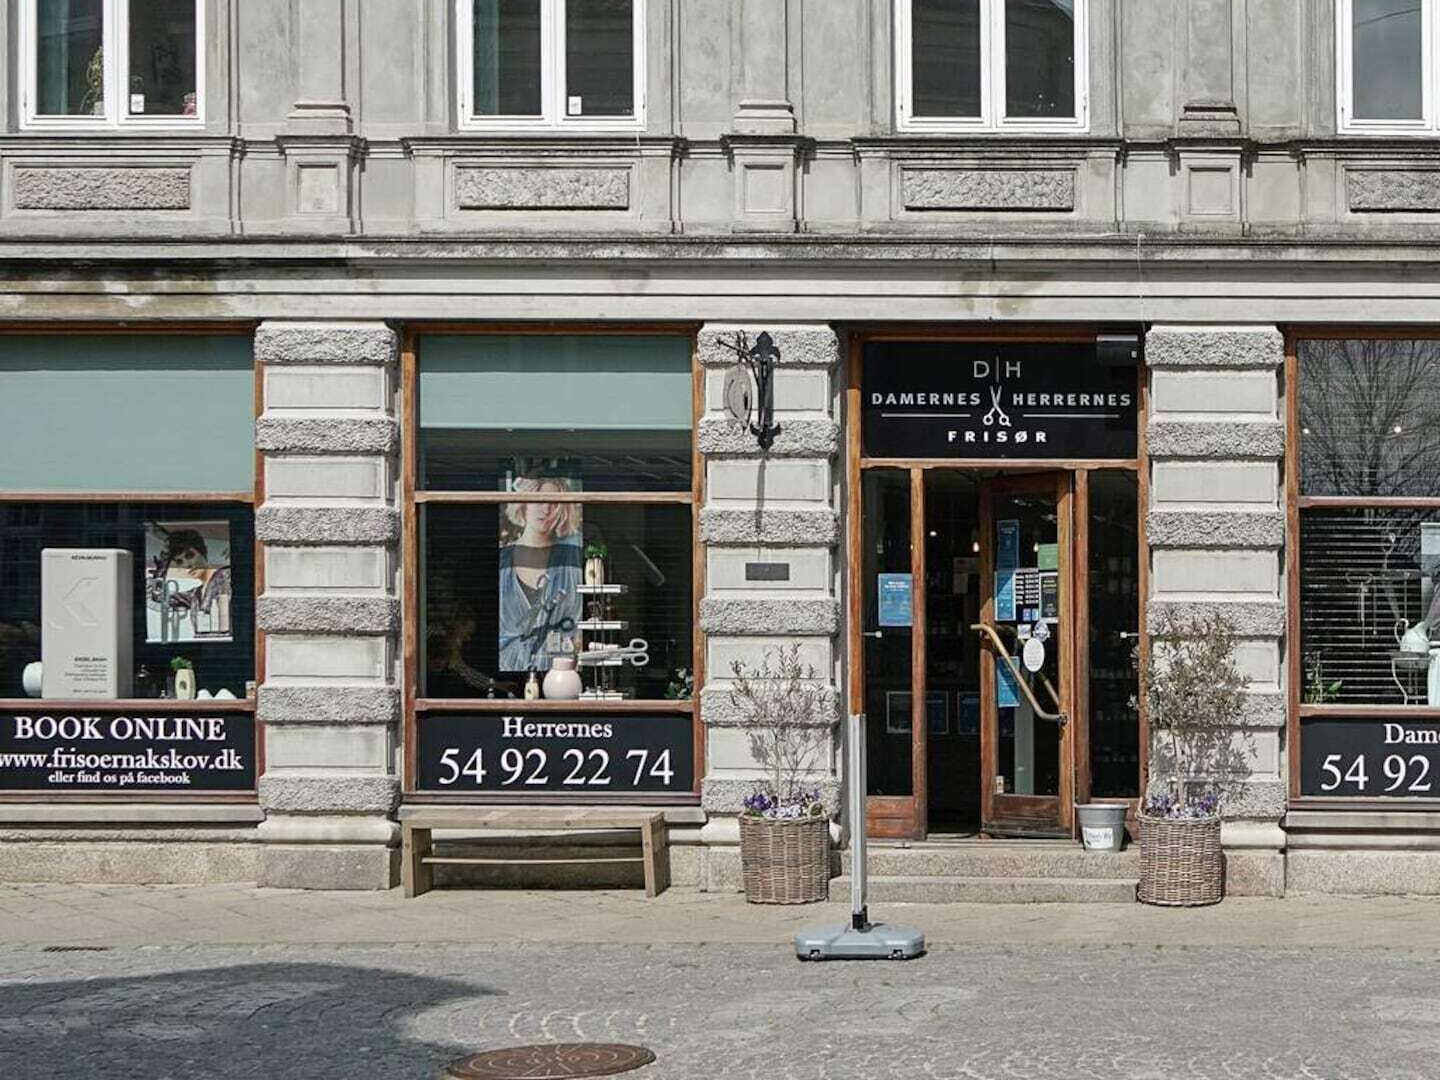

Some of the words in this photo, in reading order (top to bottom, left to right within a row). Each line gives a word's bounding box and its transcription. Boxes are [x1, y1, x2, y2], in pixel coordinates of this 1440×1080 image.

[871, 392, 981, 406] DAMERNES
[1012, 393, 1131, 407] HERRERNES
[947, 430, 1047, 443] FRISØR
[14, 716, 104, 740] BOOK
[110, 717, 226, 741] ONLINE
[502, 717, 613, 738] Herrernes
[0, 747, 244, 770] www.frisoernakskov.dk
[438, 748, 487, 785] 54
[501, 748, 549, 785] 92
[562, 748, 611, 785] 22
[625, 748, 674, 786] 74
[48, 770, 75, 783] eller
[77, 771, 100, 783] find
[103, 773, 117, 783] os
[119, 771, 134, 786] på
[137, 771, 191, 784] facebook
[1321, 754, 1369, 791] 54
[1383, 754, 1431, 792] 92
